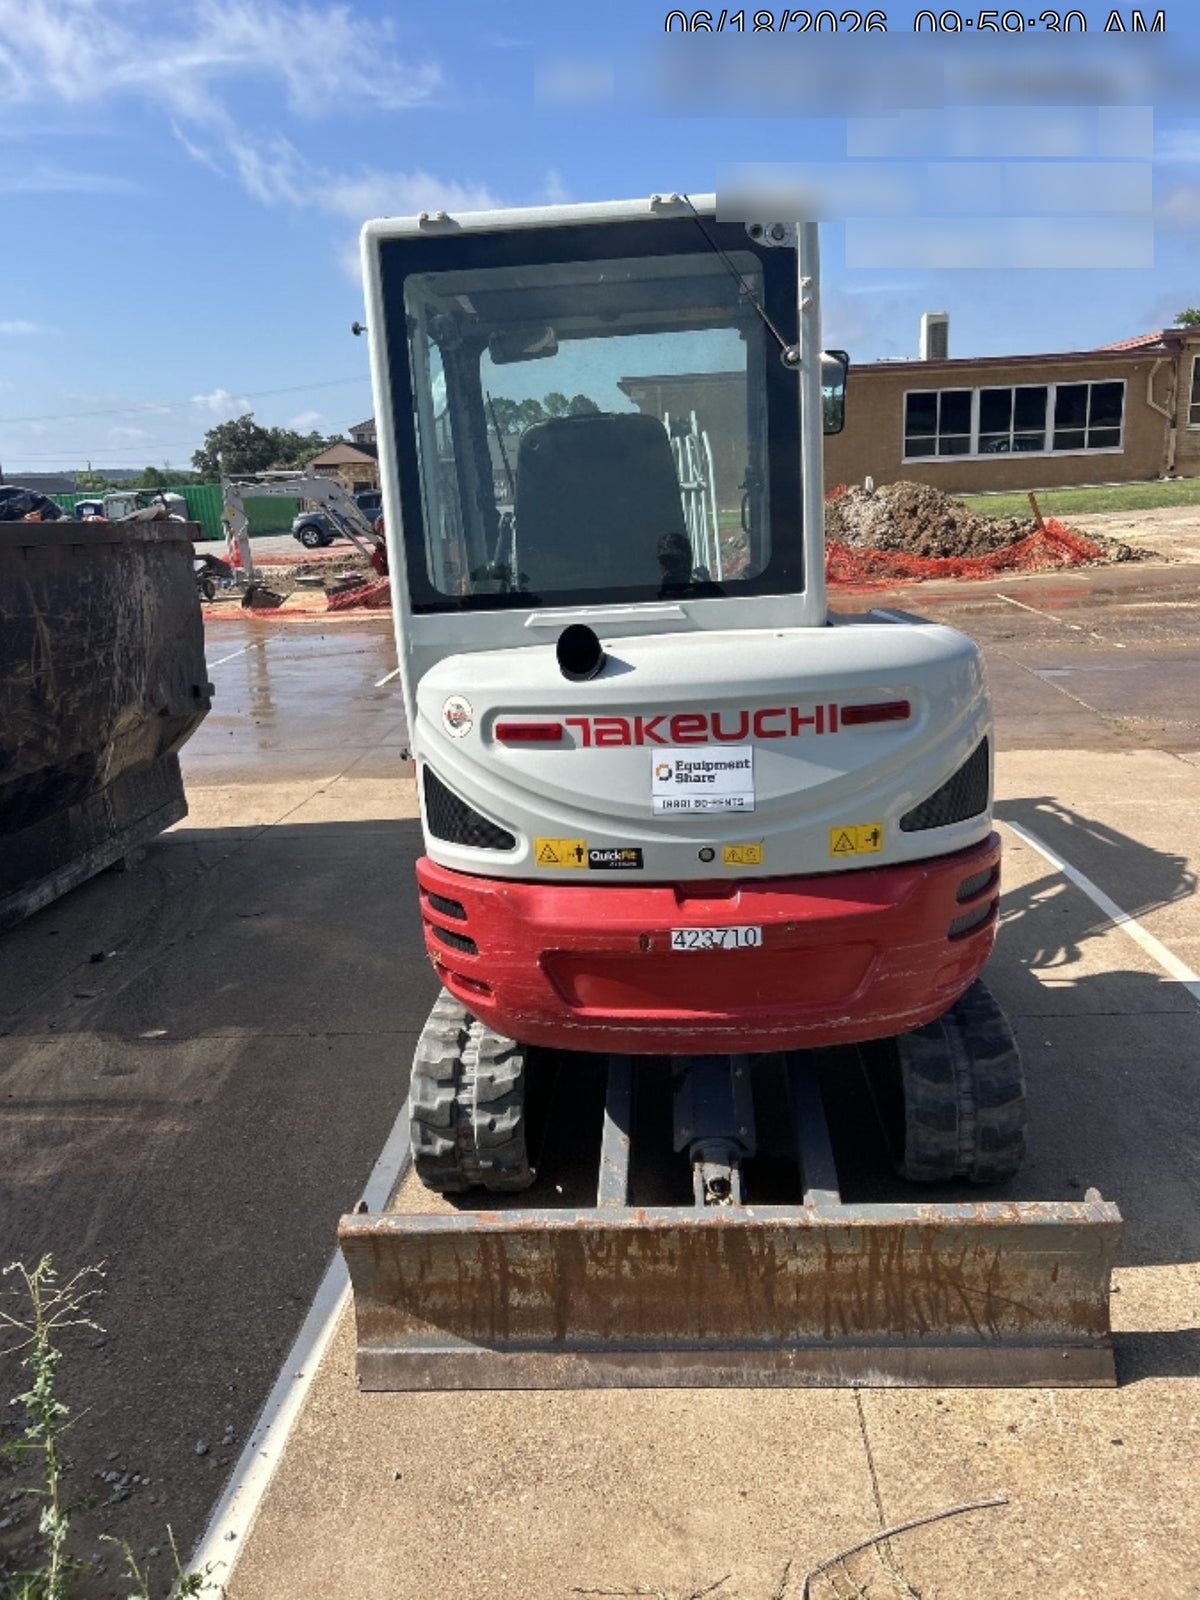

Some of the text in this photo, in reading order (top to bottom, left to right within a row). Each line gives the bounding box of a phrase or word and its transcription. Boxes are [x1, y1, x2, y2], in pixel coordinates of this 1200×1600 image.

[675, 759, 751, 773] Equipment
[675, 773, 716, 783] Share
[673, 927, 757, 948] 423710
